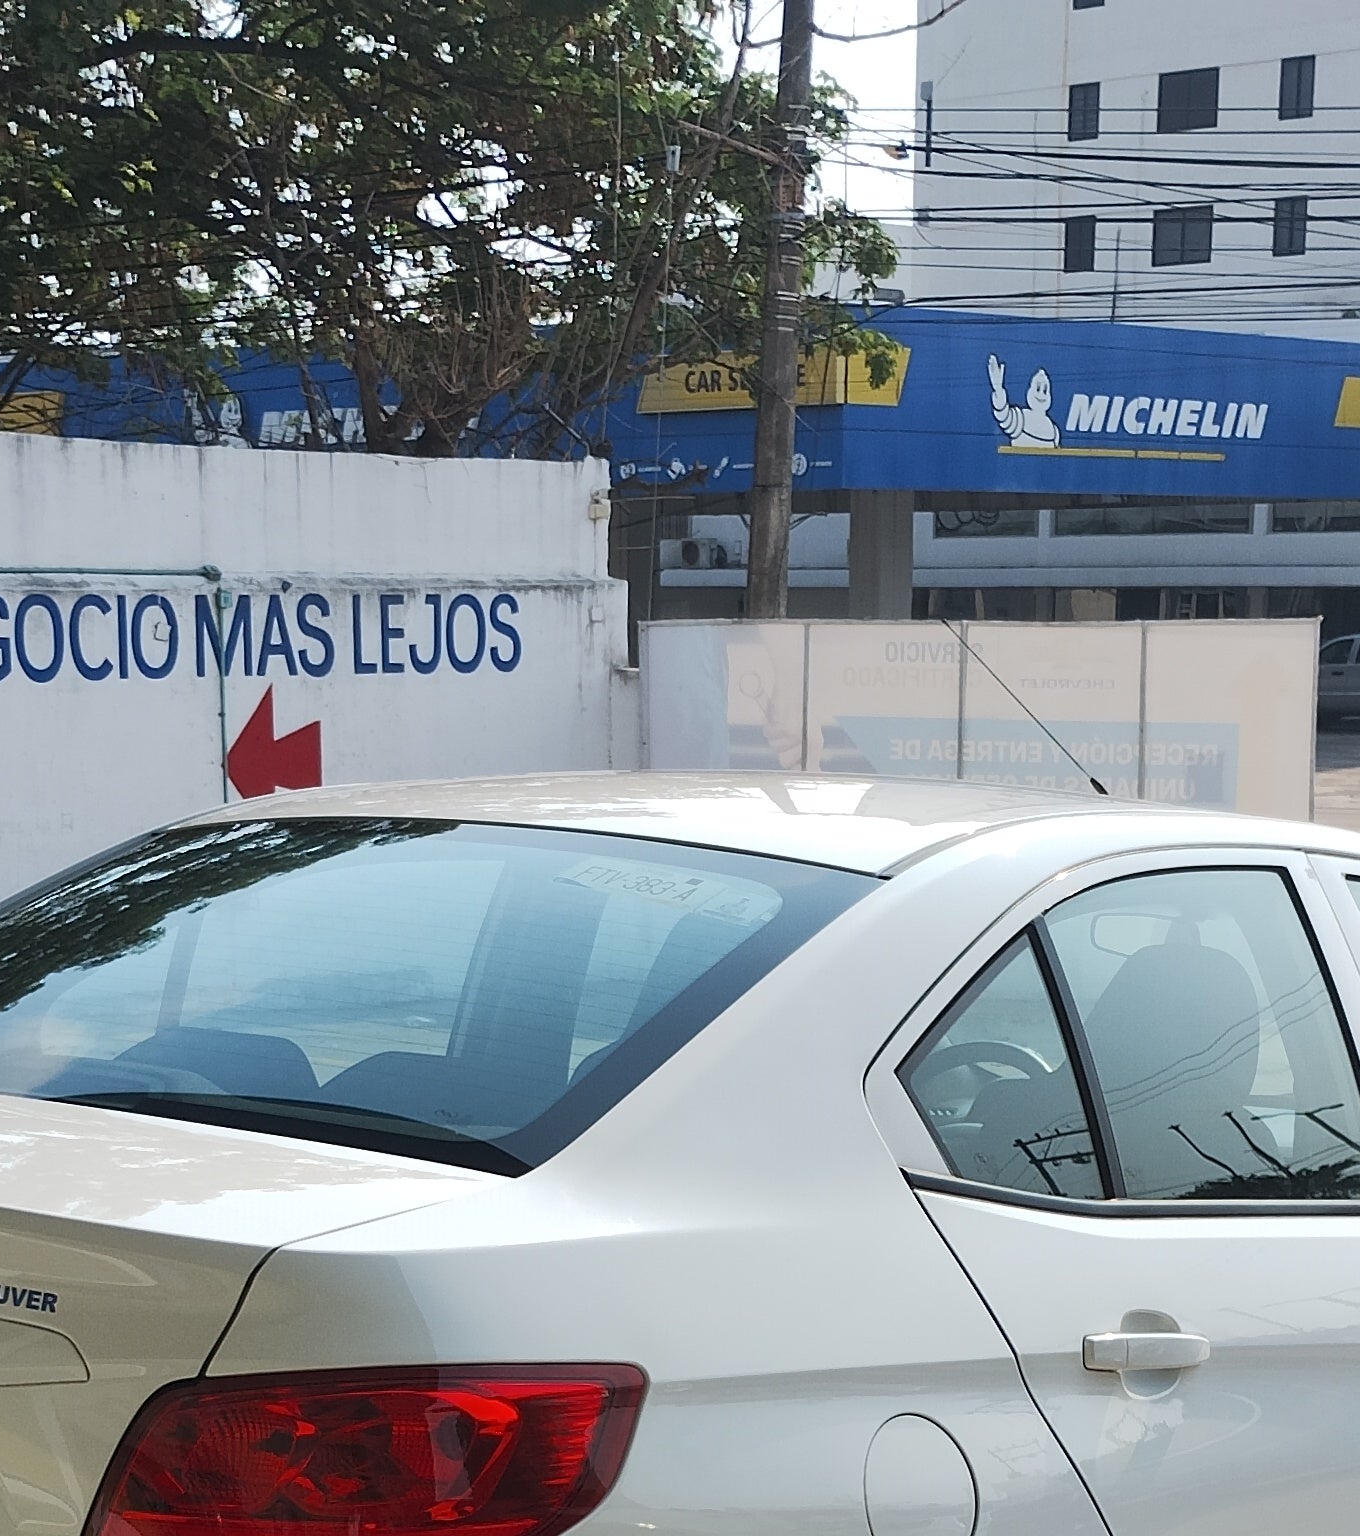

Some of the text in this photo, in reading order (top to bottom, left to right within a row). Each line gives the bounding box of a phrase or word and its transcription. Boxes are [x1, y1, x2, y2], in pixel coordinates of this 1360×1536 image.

[685, 370, 722, 394] CAR
[1065, 393, 1269, 439] MICHELIN
[194, 580, 336, 679] MÁS
[352, 592, 522, 675] LEJOS
